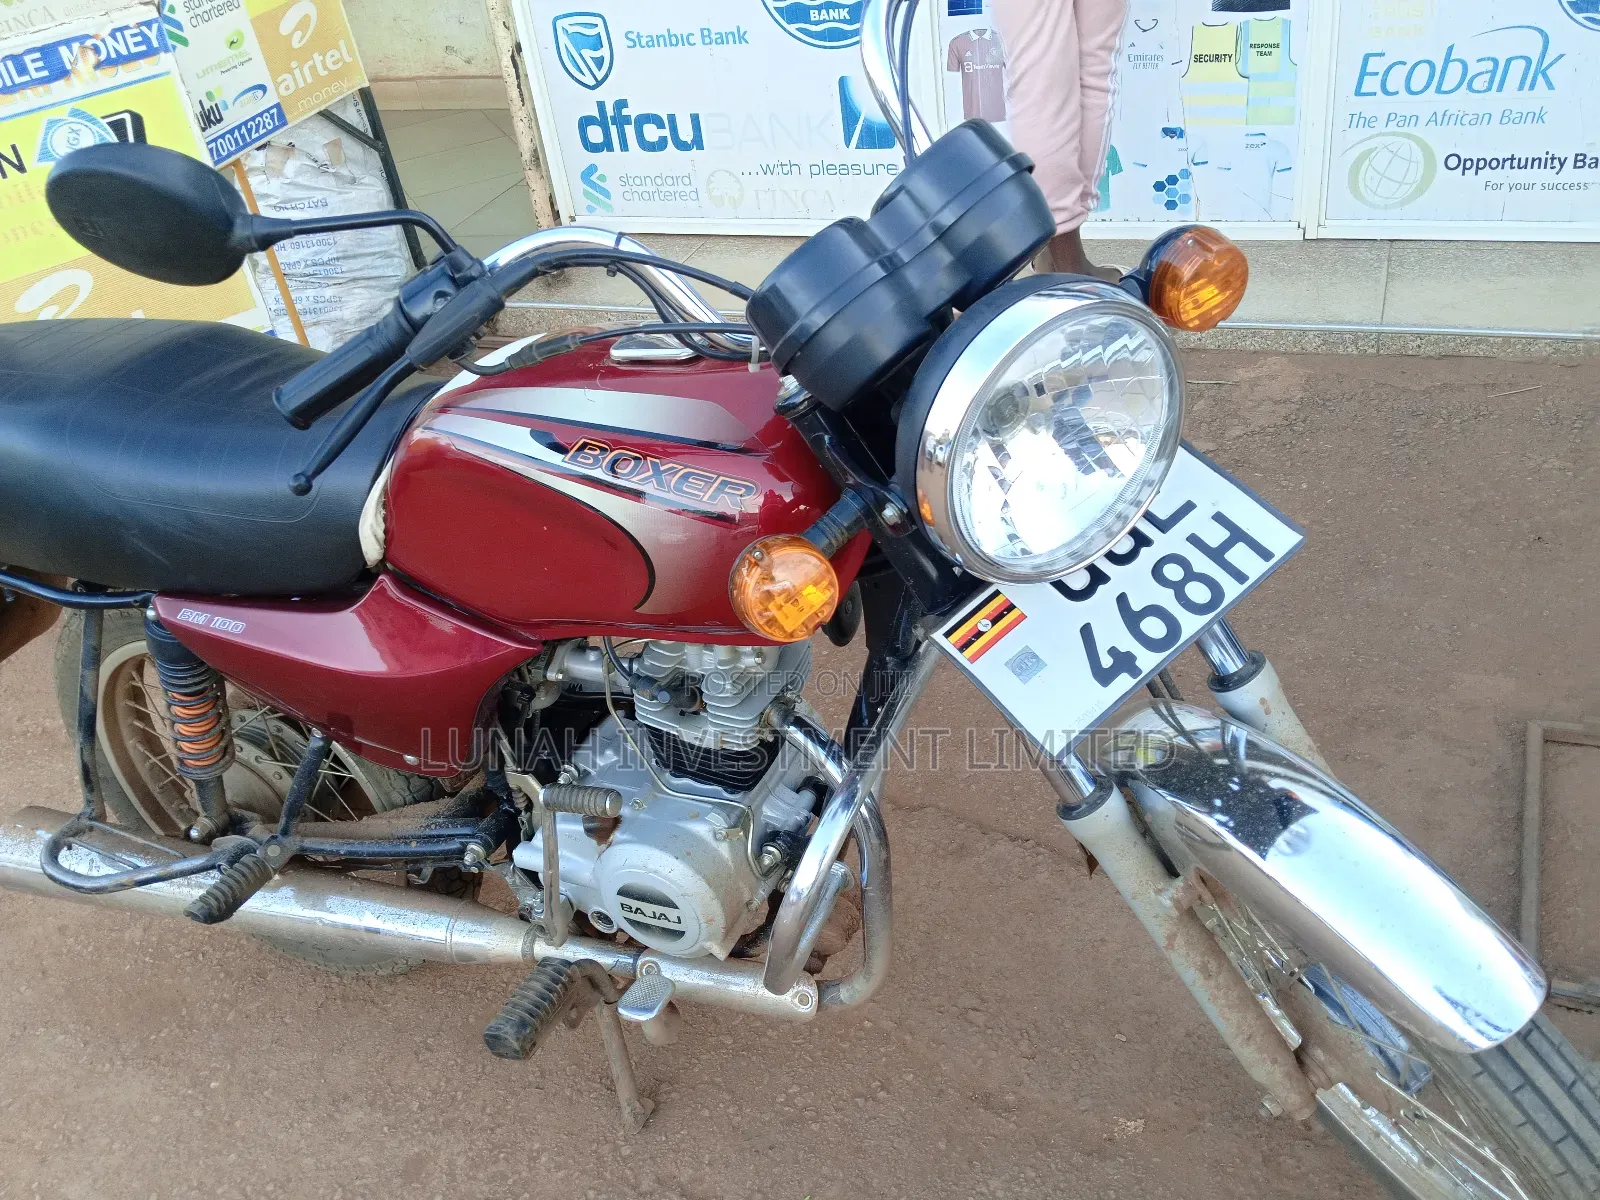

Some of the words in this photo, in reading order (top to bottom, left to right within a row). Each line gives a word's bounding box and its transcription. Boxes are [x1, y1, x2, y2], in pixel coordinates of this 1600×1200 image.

[809, 8, 850, 21] BANK
[624, 28, 696, 49] Stanbic
[700, 25, 749, 46] Bank
[1249, 42, 1280, 50] RESPONSE
[0, 52, 50, 88] ILE
[58, 23, 161, 70] MONEY
[1127, 52, 1164, 63] Emirates
[1193, 53, 1233, 63] SECURITY
[1354, 25, 1567, 97] Ecobank
[276, 39, 354, 97] airtel
[297, 78, 348, 112] money
[578, 98, 705, 153] dfcu
[1348, 113, 1378, 129] The
[1385, 111, 1419, 128] Pan
[1425, 109, 1493, 127] African
[1499, 106, 1548, 125] Bank
[208, 107, 281, 161] 700112287
[810, 159, 900, 179] pleasure
[1444, 151, 1567, 176] Opportunity
[619, 173, 693, 188] standard
[1483, 180, 1504, 191] For
[1508, 181, 1536, 193] your
[622, 187, 699, 203] chartered
[752, 189, 837, 211] FINCA
[562, 435, 762, 512] BOXER
[1080, 511, 1275, 688] 468H
[177, 608, 210, 624] BM
[210, 616, 246, 633] 100
[620, 902, 682, 925] BAJAJ
